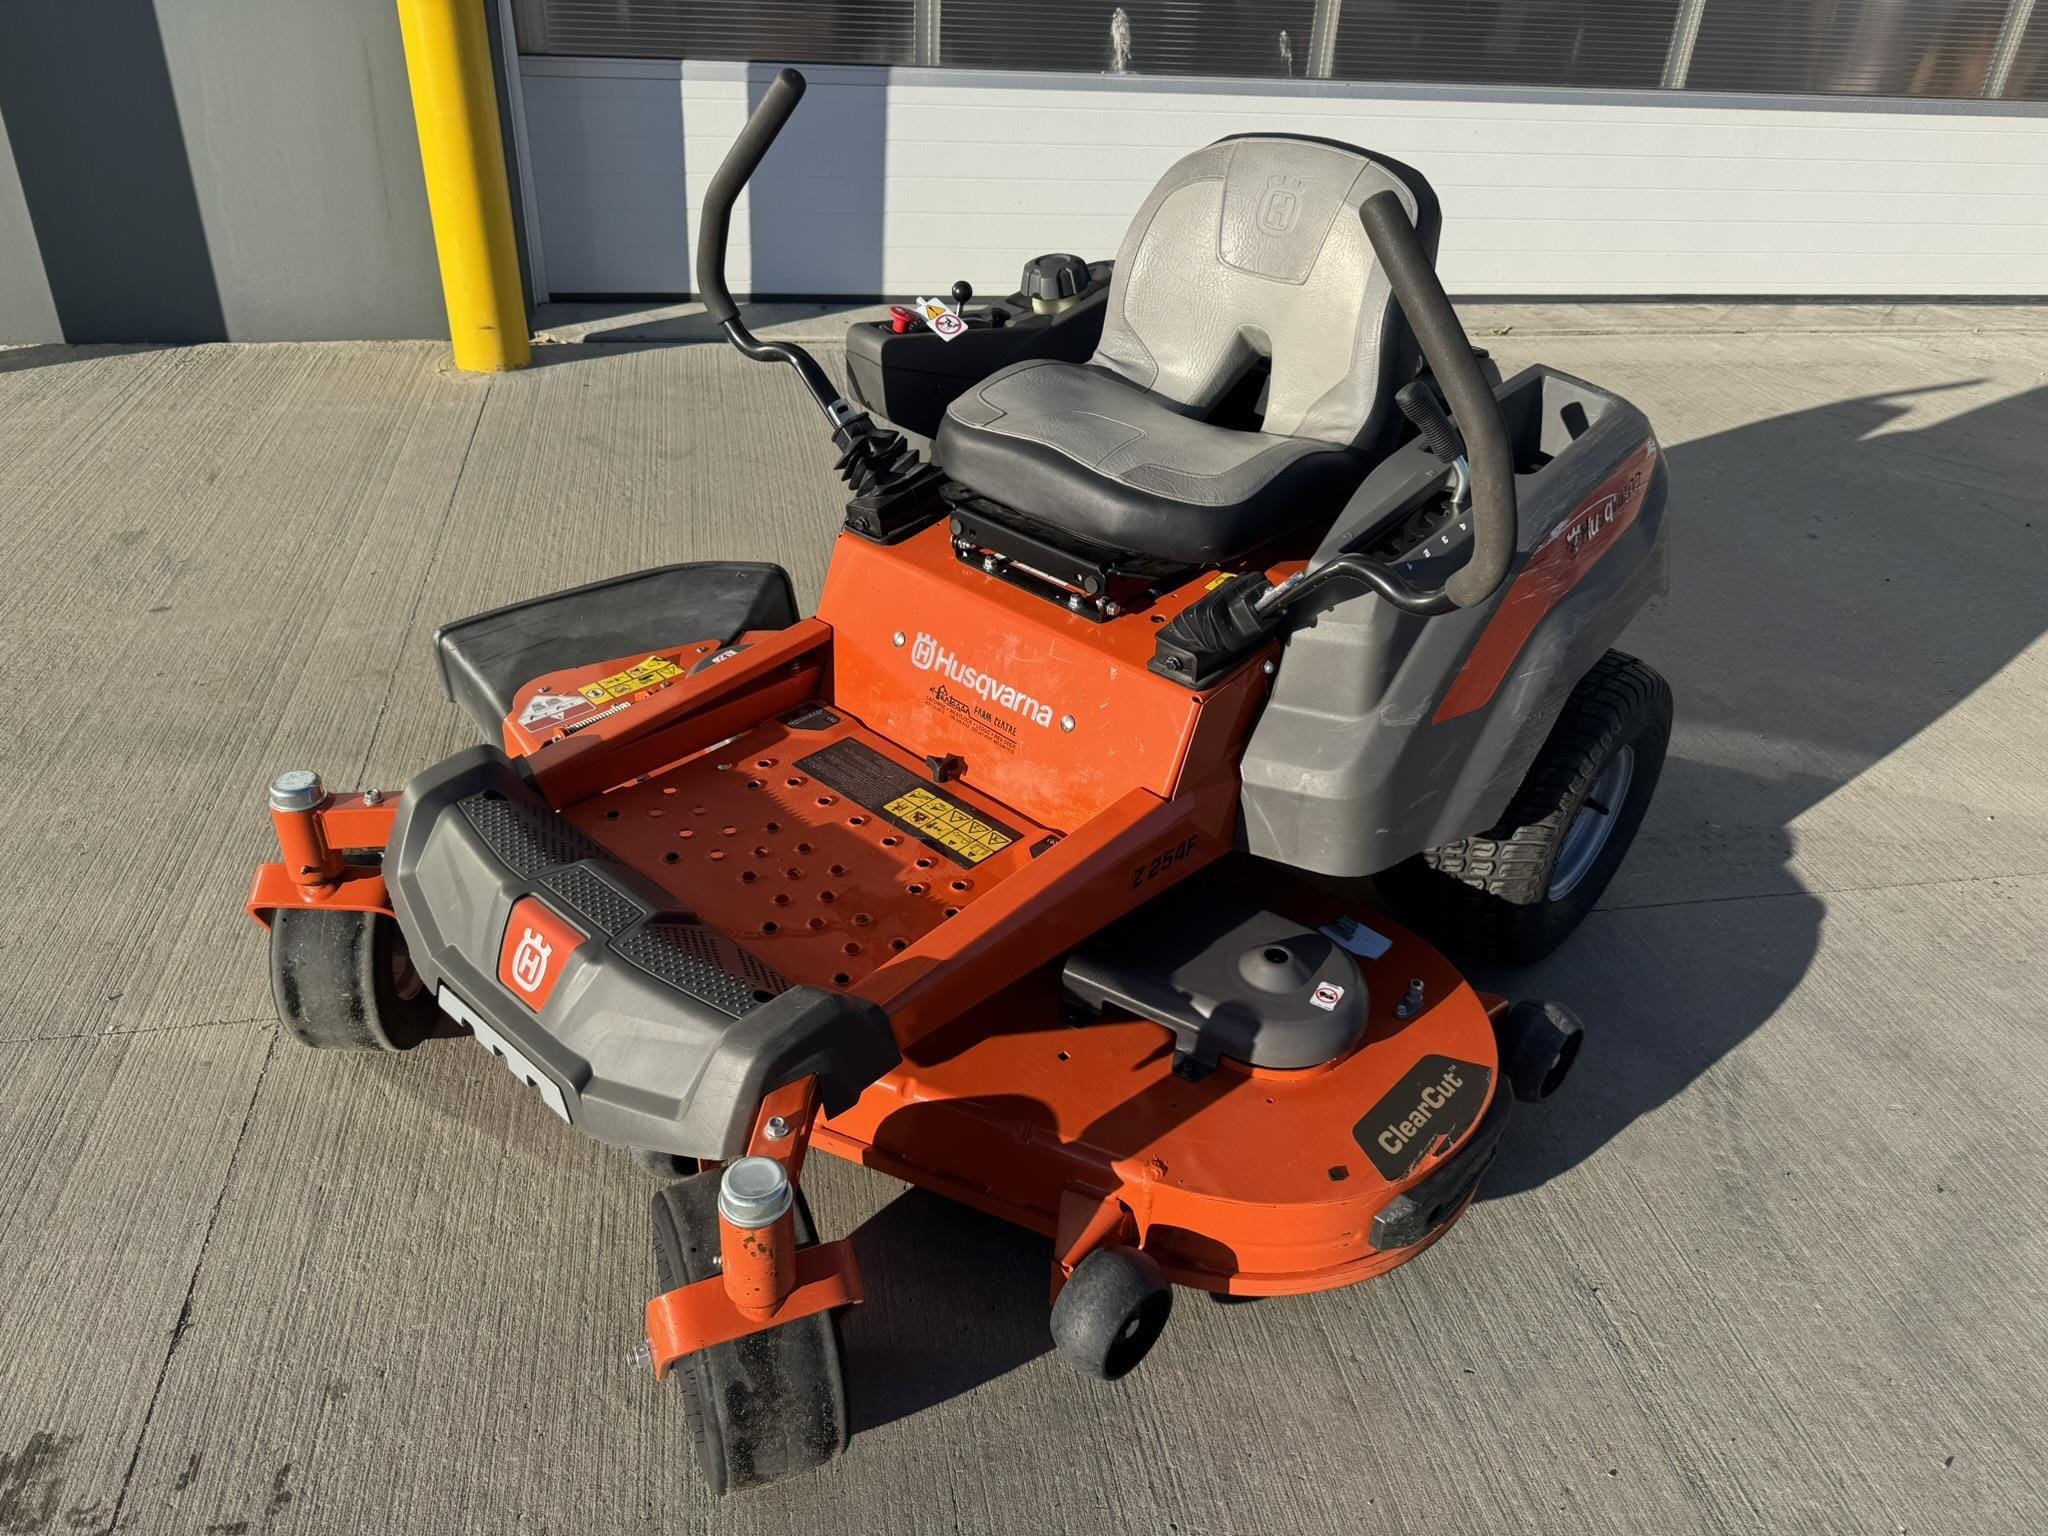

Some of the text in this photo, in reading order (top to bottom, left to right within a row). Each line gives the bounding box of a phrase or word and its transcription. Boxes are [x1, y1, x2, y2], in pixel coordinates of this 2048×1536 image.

[934, 647, 1054, 728] Husqvarna
[993, 717, 1017, 737] CENTRE
[1132, 834, 1199, 890] Z 254F
